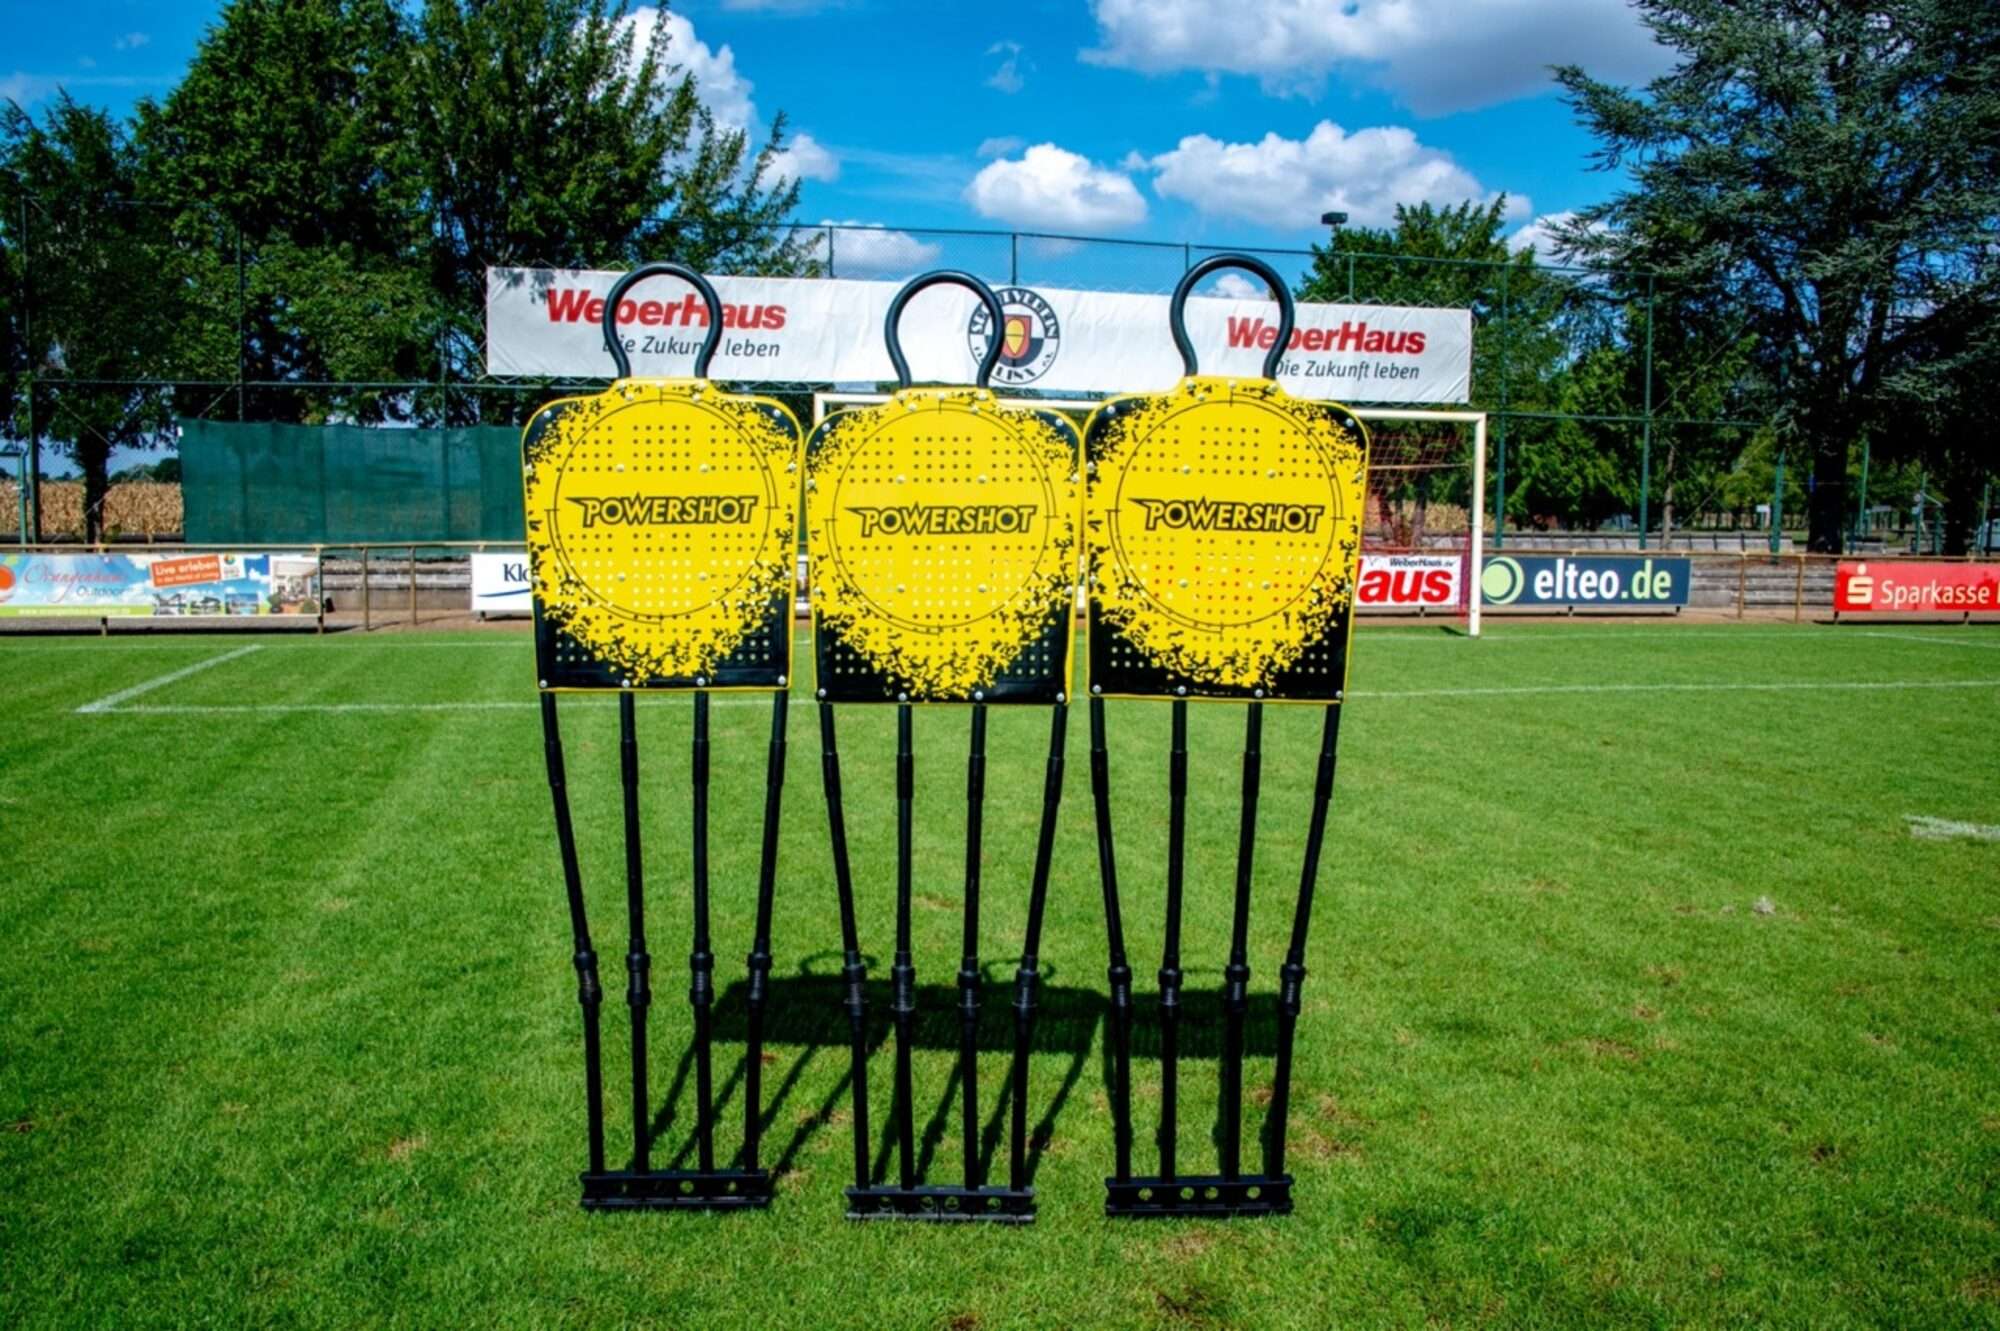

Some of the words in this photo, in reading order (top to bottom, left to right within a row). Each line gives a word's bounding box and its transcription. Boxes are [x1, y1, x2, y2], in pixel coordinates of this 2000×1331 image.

[547, 289, 787, 330] WeberHaus
[641, 335, 718, 357] Zukun
[724, 338, 781, 357] leben
[1304, 360, 1370, 382] Zukunft
[1373, 362, 1420, 380] leben
[566, 491, 759, 528] POWERSHOT
[845, 501, 1038, 538] POWERSHOT
[1128, 496, 1325, 534] POWERSHOT
[1356, 558, 1453, 603] aus
[1533, 558, 1673, 600] elteo.de
[1879, 579, 1991, 610] Sparkasse
